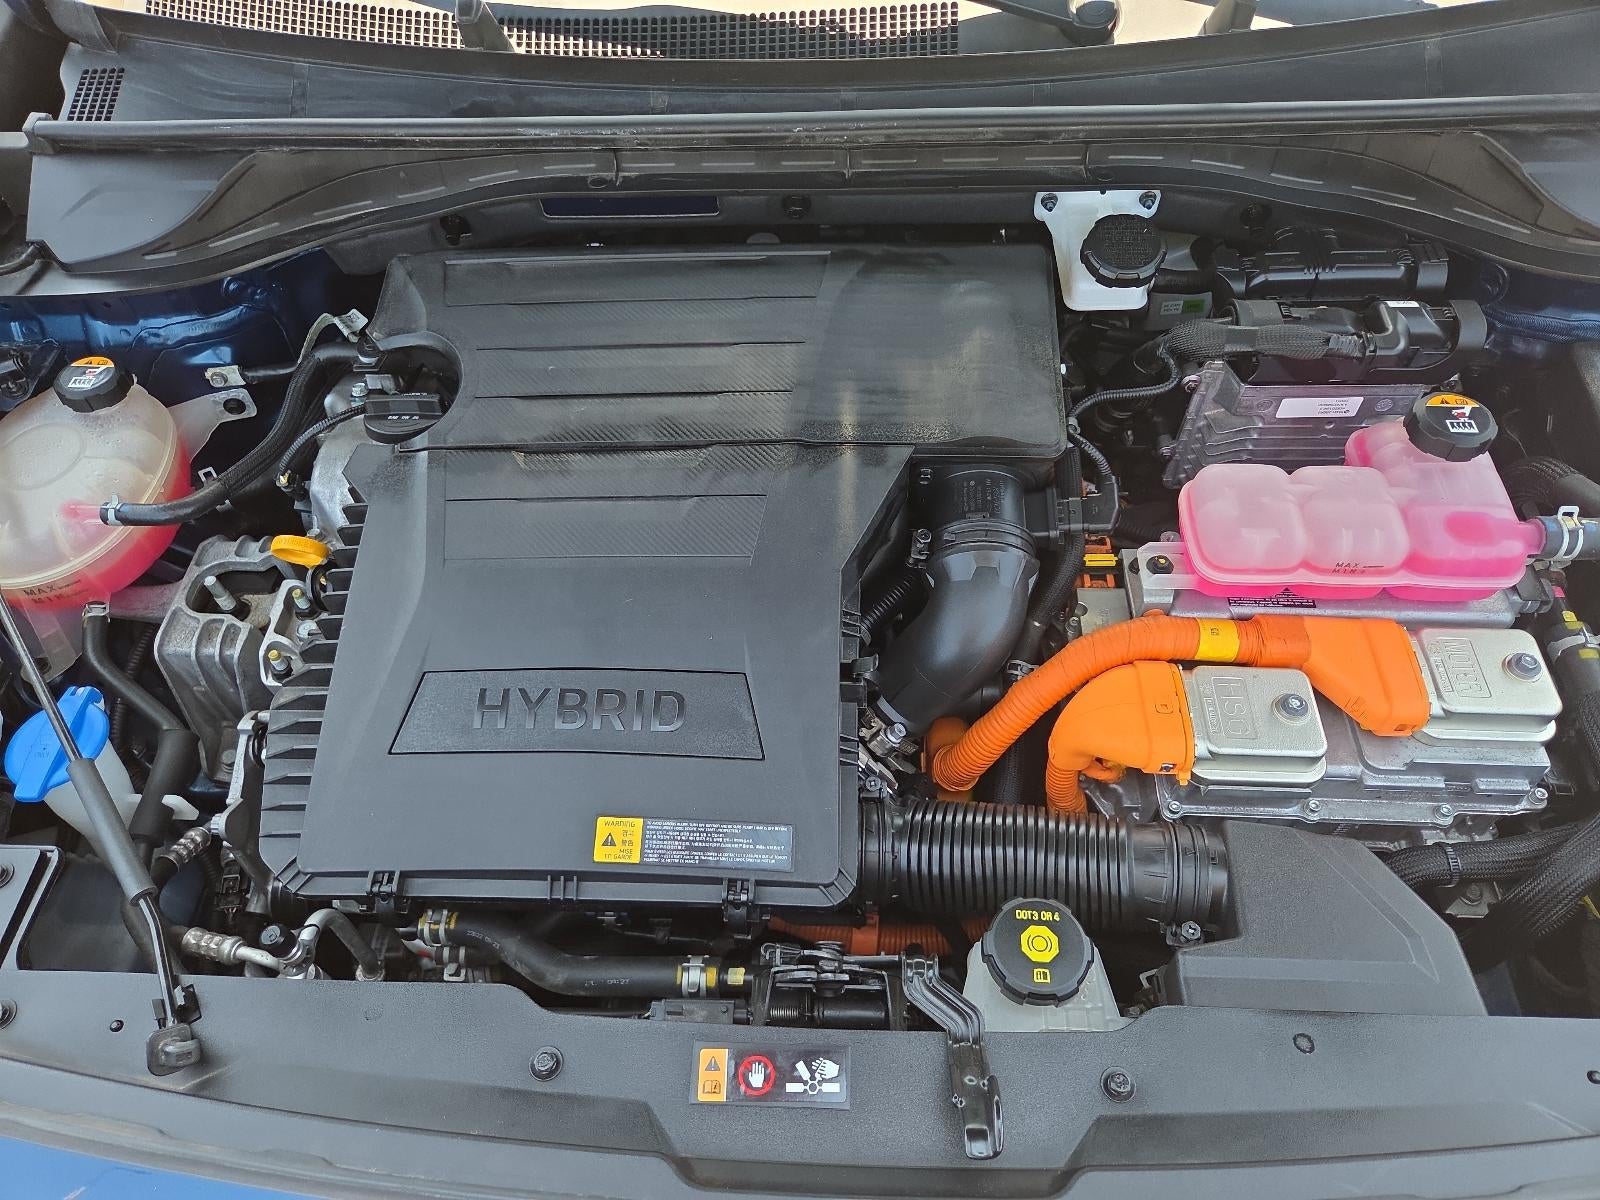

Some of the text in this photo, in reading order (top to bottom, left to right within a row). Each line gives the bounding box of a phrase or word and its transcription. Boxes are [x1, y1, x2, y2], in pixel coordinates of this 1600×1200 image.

[23, 585, 56, 596] MAX
[473, 688, 686, 732] HYBRID
[604, 820, 636, 828] WARNING
[1015, 909, 1060, 921] DOT3 OR 4
